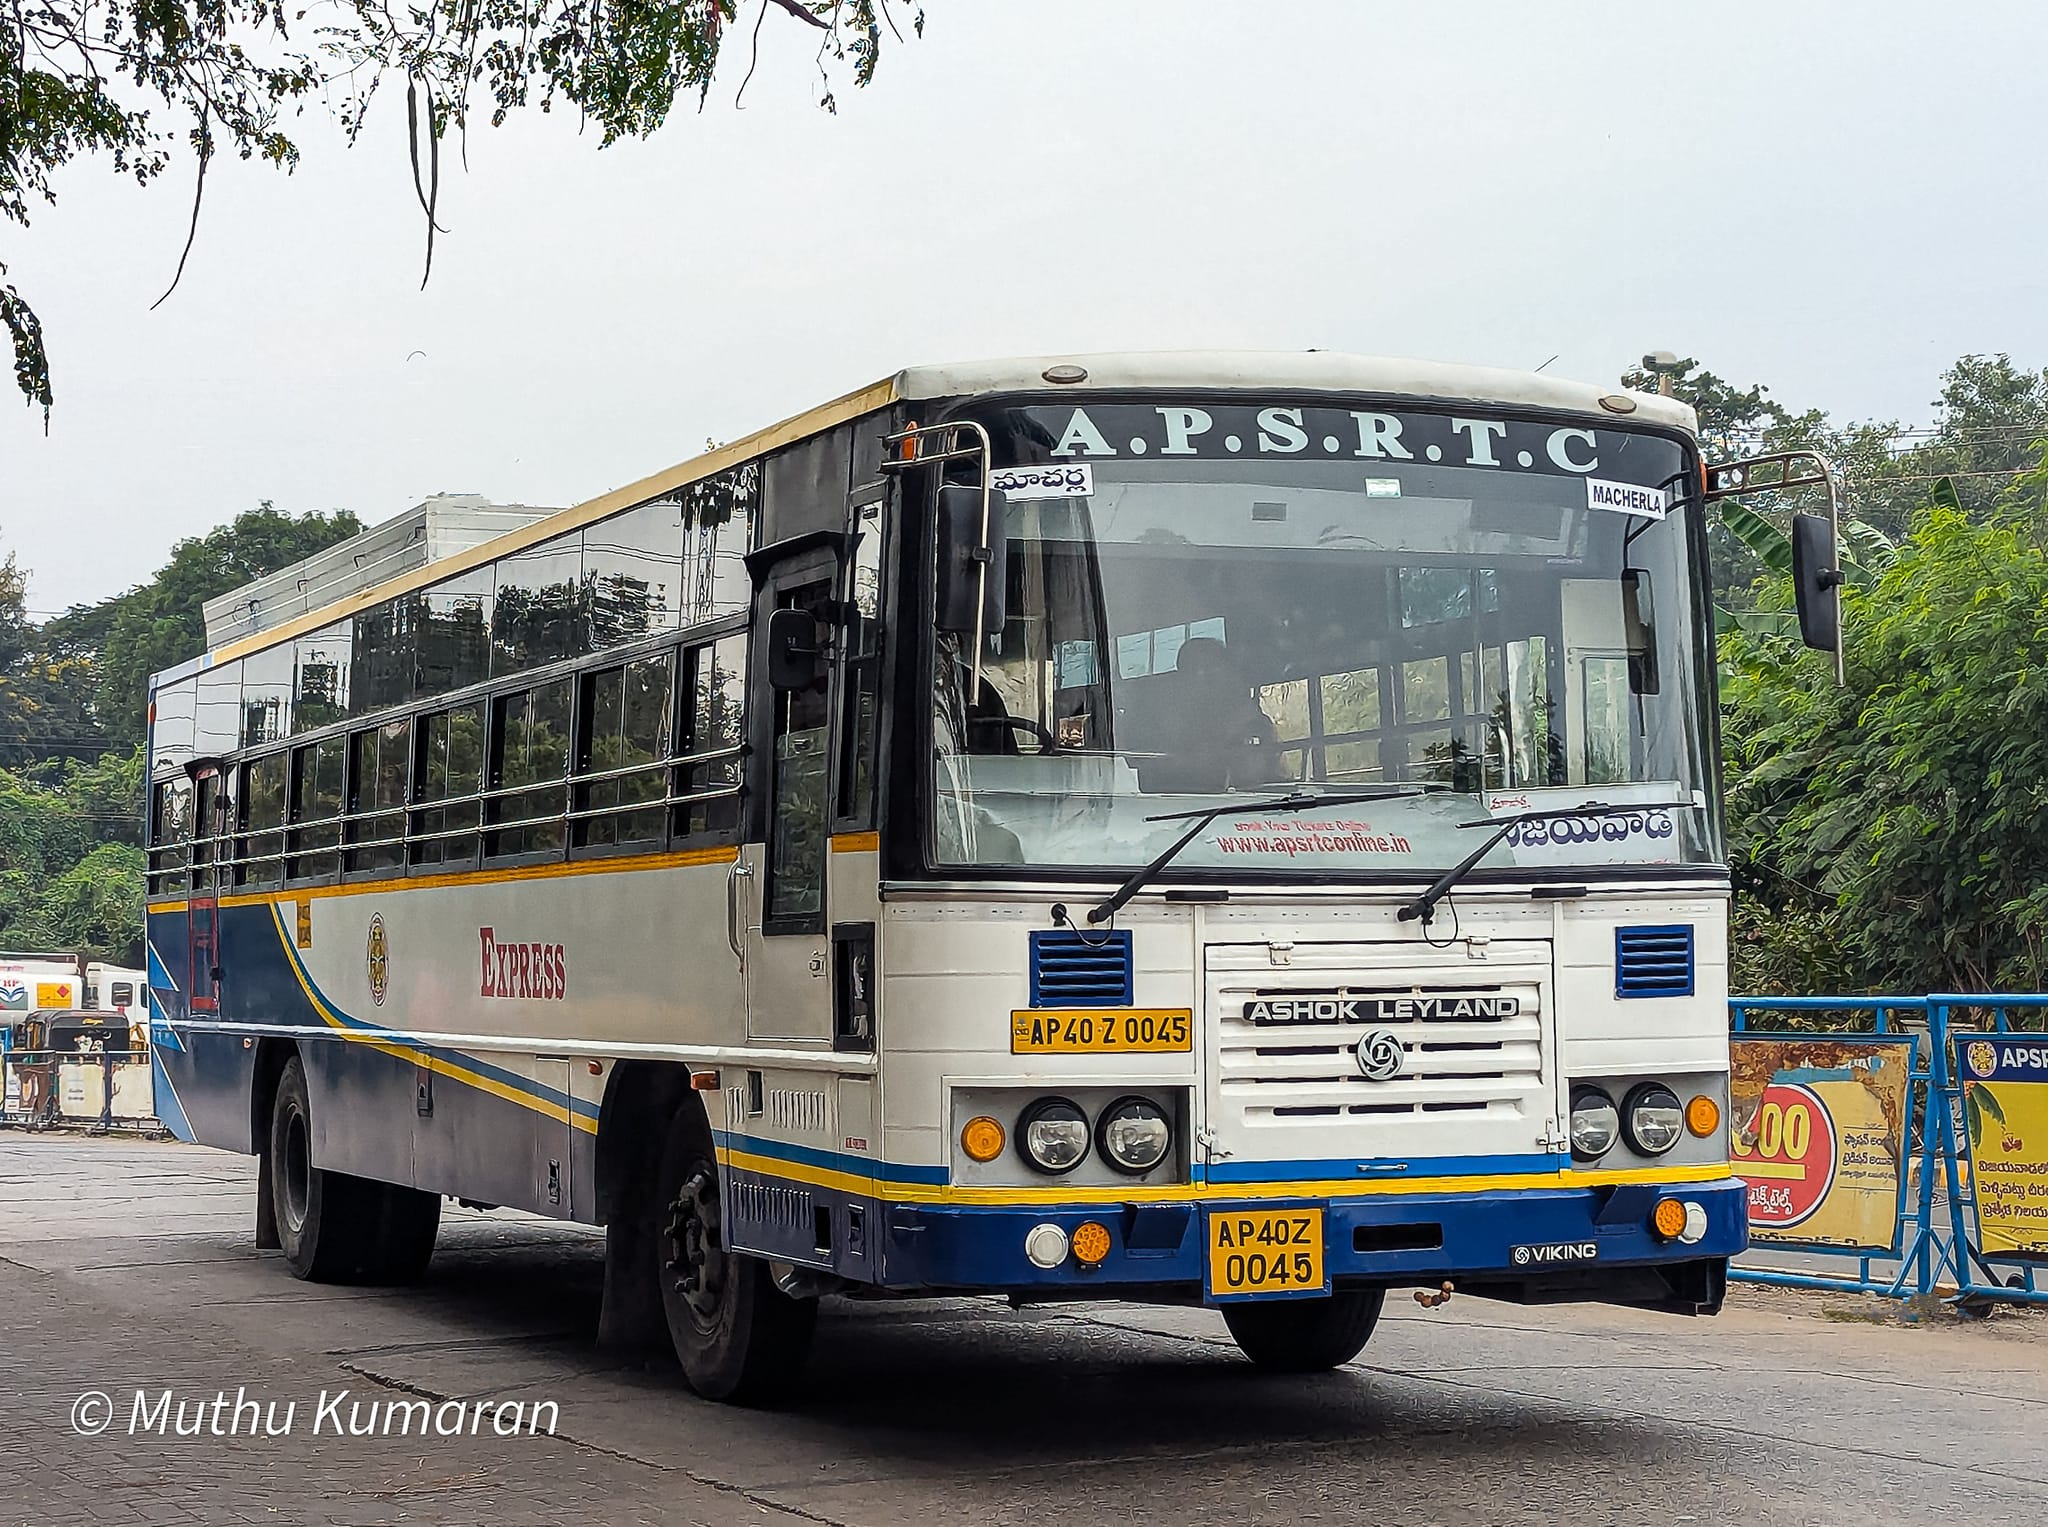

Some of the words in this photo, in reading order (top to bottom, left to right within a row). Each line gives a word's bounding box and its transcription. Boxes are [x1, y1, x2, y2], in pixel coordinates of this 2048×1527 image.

[1050, 406, 1599, 474] A.P.S.R.T.C
[994, 468, 1087, 492] మాచర్ల
[1593, 484, 1662, 514] MACHERLA
[1216, 832, 1412, 857] www.apsrtconline.in
[1248, 1001, 1360, 1021] ASHOK
[1377, 997, 1519, 1019] LEYLAND
[1125, 1015, 1188, 1045] 0045
[1218, 1217, 1312, 1249] AP40Z
[1531, 1243, 1597, 1262] VIKING
[1226, 1252, 1313, 1287] 0045
